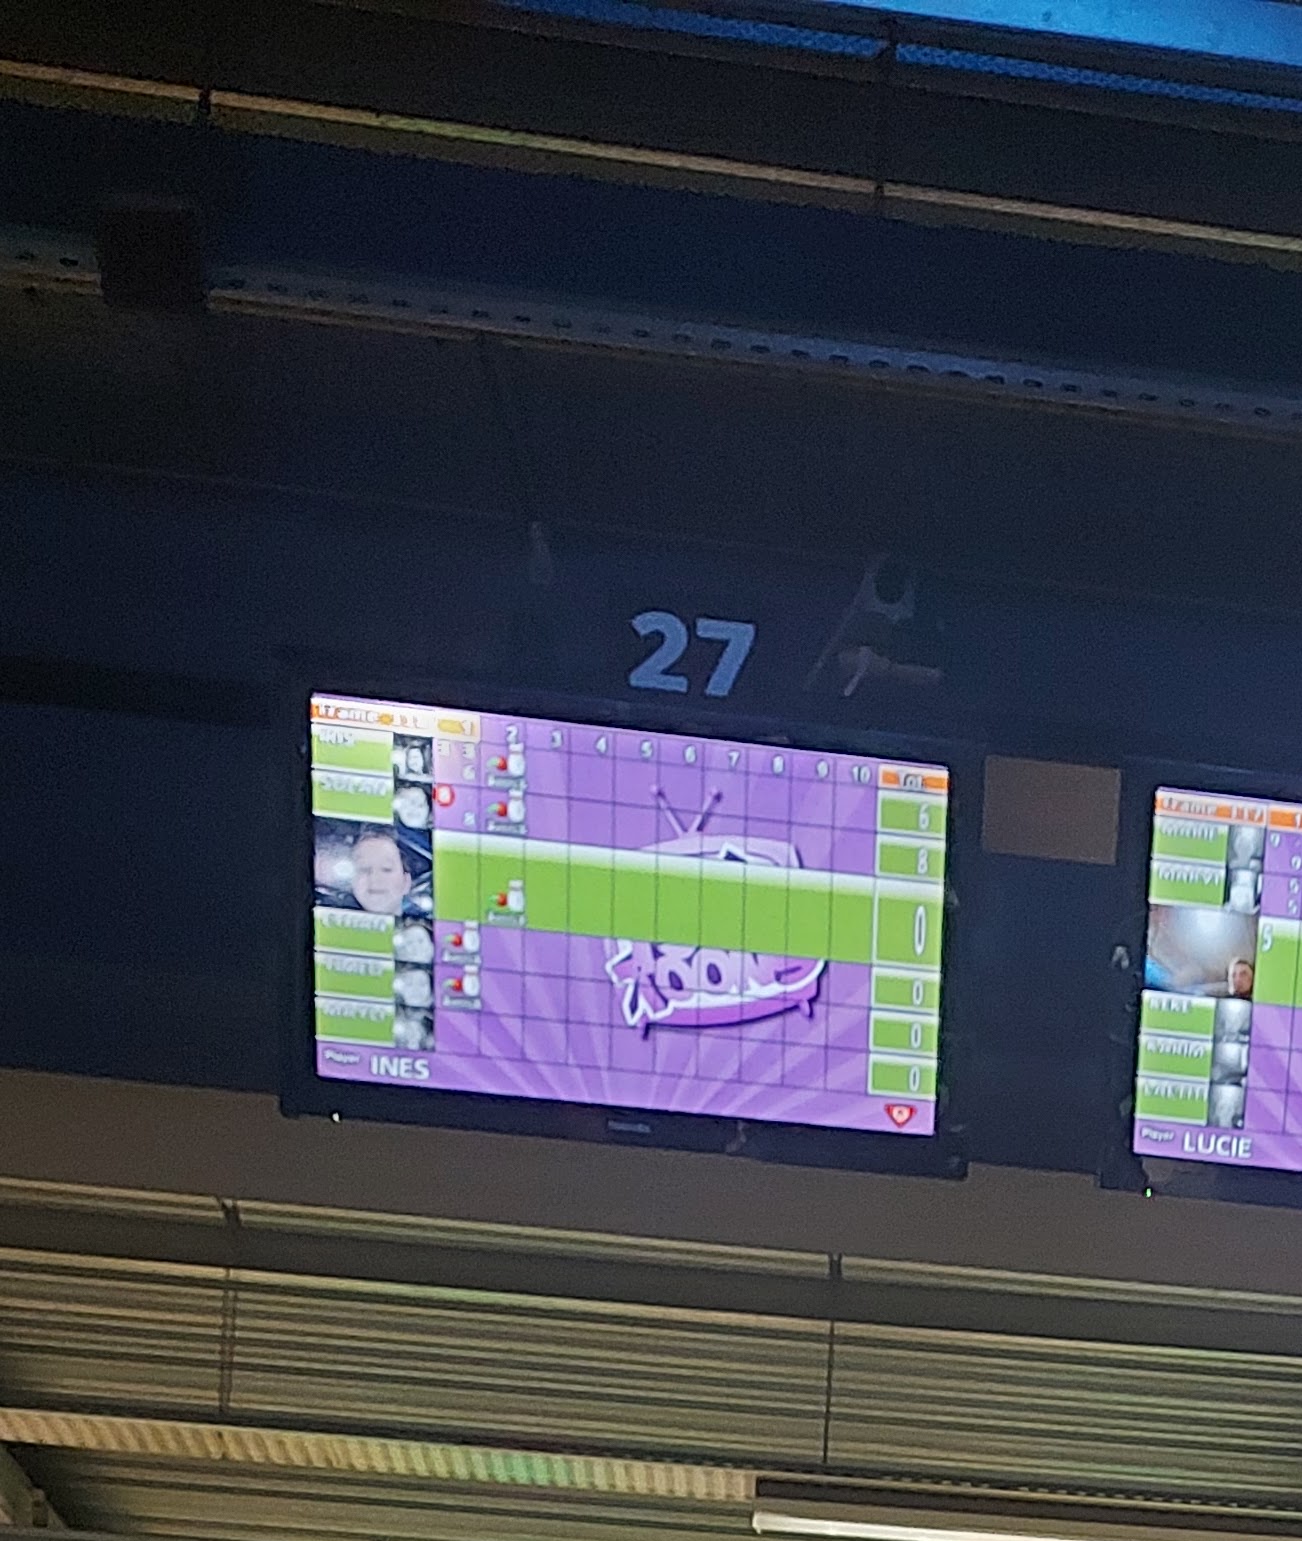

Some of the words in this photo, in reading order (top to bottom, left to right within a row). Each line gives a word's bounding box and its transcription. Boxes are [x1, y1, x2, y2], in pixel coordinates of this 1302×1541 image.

[628, 611, 756, 697] 27
[505, 725, 519, 743] 2
[551, 730, 563, 748] 3
[596, 736, 608, 754] 4
[640, 740, 653, 758] 5
[684, 744, 696, 763] 6
[728, 750, 740, 768] 7
[772, 754, 785, 774] 8
[816, 759, 829, 779] 9
[851, 763, 871, 785] 10
[919, 802, 930, 827] 6
[917, 848, 928, 874] 8
[913, 904, 926, 955] 0
[1261, 923, 1273, 952] 5
[912, 979, 924, 1006] 0
[910, 1022, 922, 1049] 0
[370, 1054, 431, 1080] INES
[908, 1064, 920, 1091] 0
[1140, 1126, 1175, 1144] Player
[1183, 1130, 1252, 1158] LUCIE
